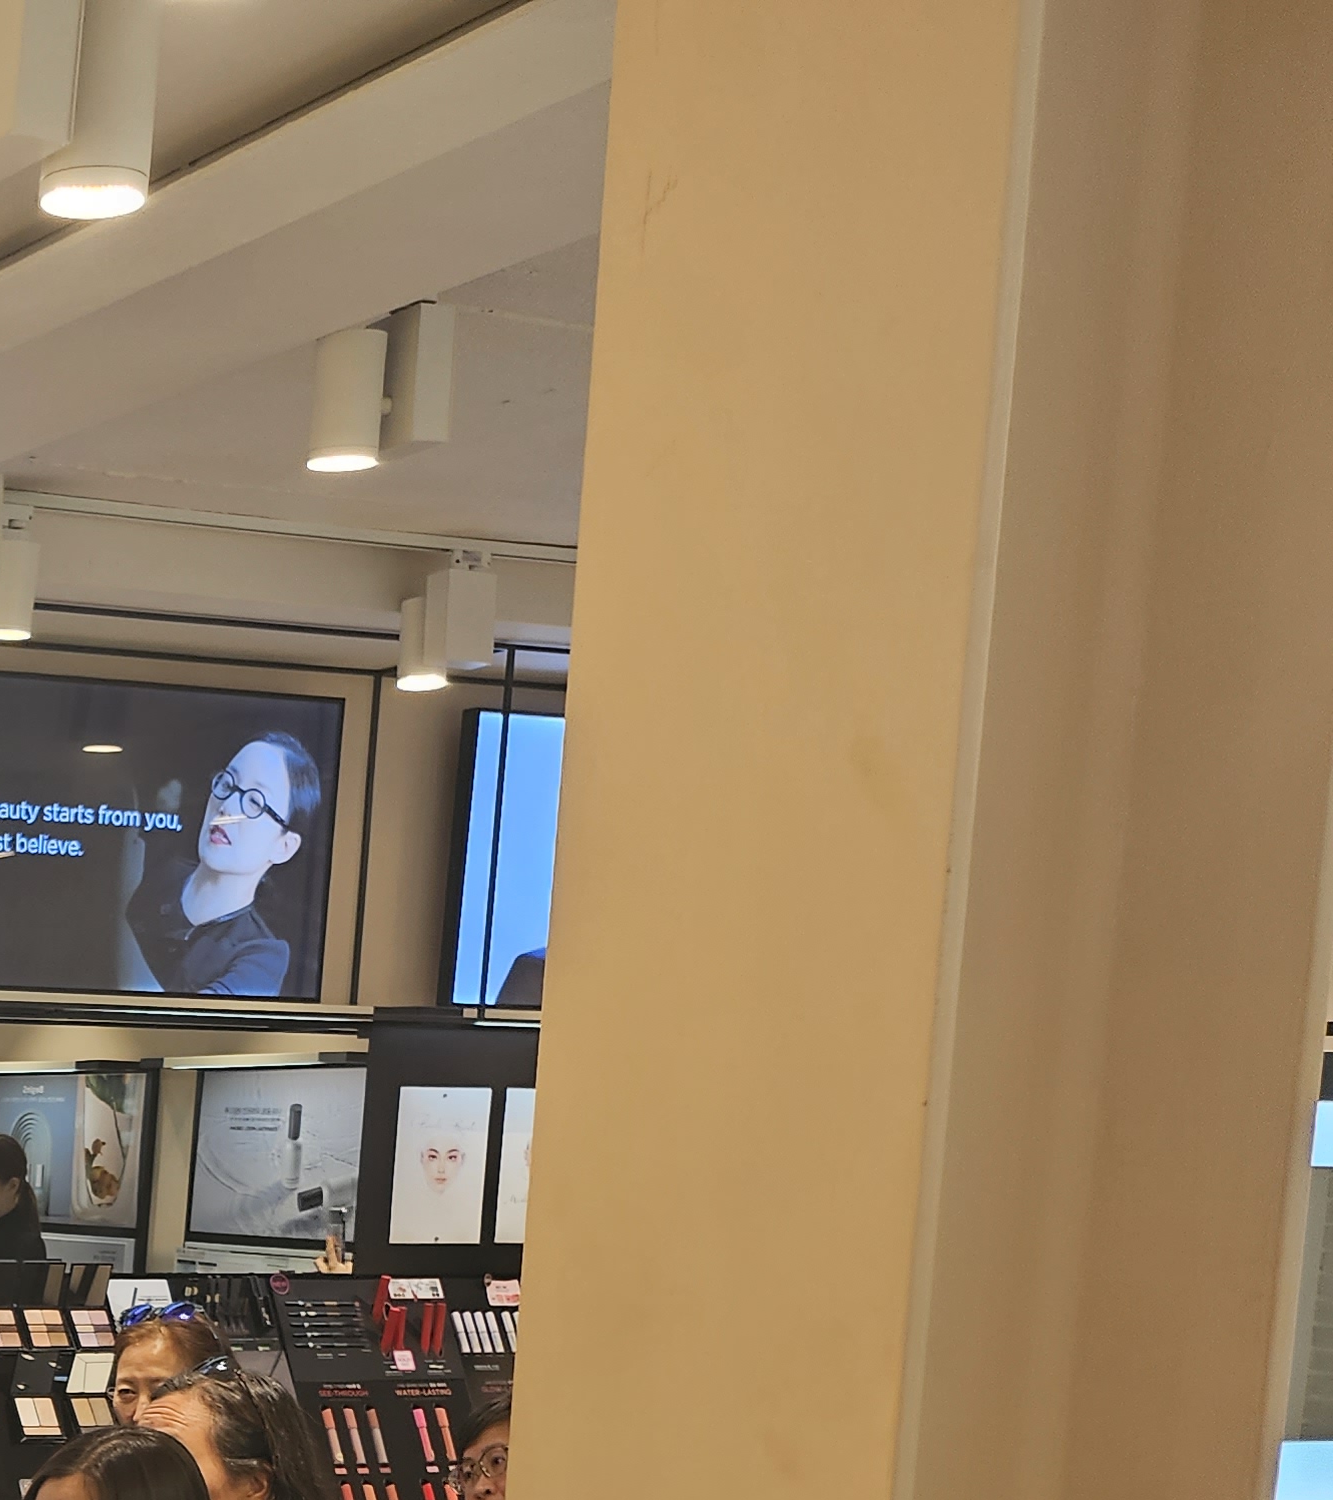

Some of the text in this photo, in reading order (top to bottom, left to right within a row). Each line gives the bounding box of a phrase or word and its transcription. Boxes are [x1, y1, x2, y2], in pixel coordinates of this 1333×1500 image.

[42, 802, 95, 825] starts
[97, 804, 141, 827] from
[143, 811, 182, 832] you,
[15, 832, 85, 857] believe.
[394, 1388, 452, 1397] WATER-LASTING
